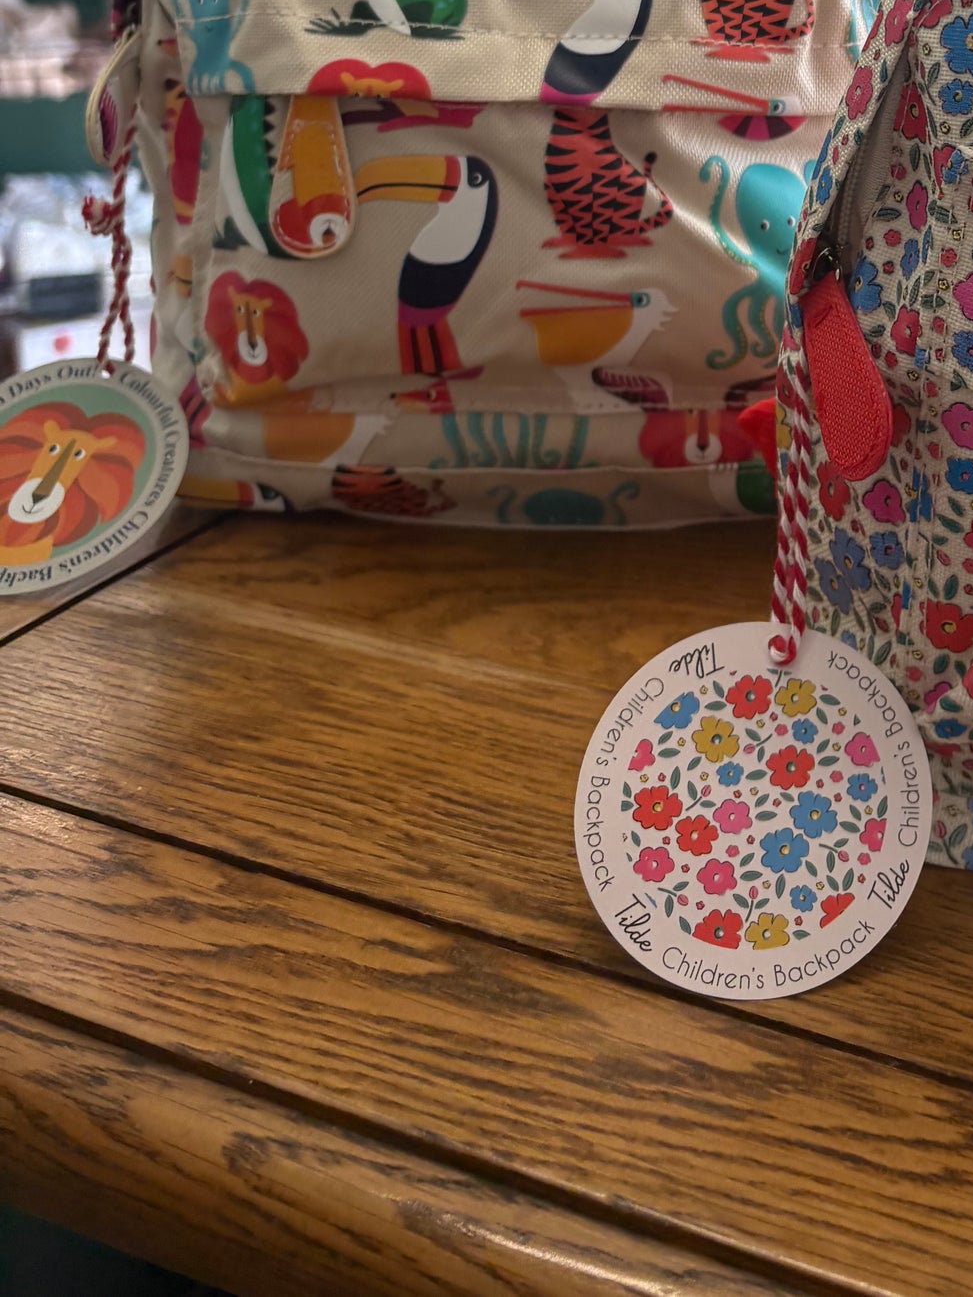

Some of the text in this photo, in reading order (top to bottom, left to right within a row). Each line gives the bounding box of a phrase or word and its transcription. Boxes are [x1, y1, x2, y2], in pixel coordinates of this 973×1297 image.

[9, 365, 99, 398] Days Out!
[119, 372, 179, 430] Colourful
[144, 430, 180, 507] Creatures
[58, 510, 149, 573] Children's
[583, 642, 724, 892] Tilde Children's Backpack
[827, 650, 921, 910] Tilde Children's Backpack
[614, 892, 875, 990] Tilde Children's Backpack
